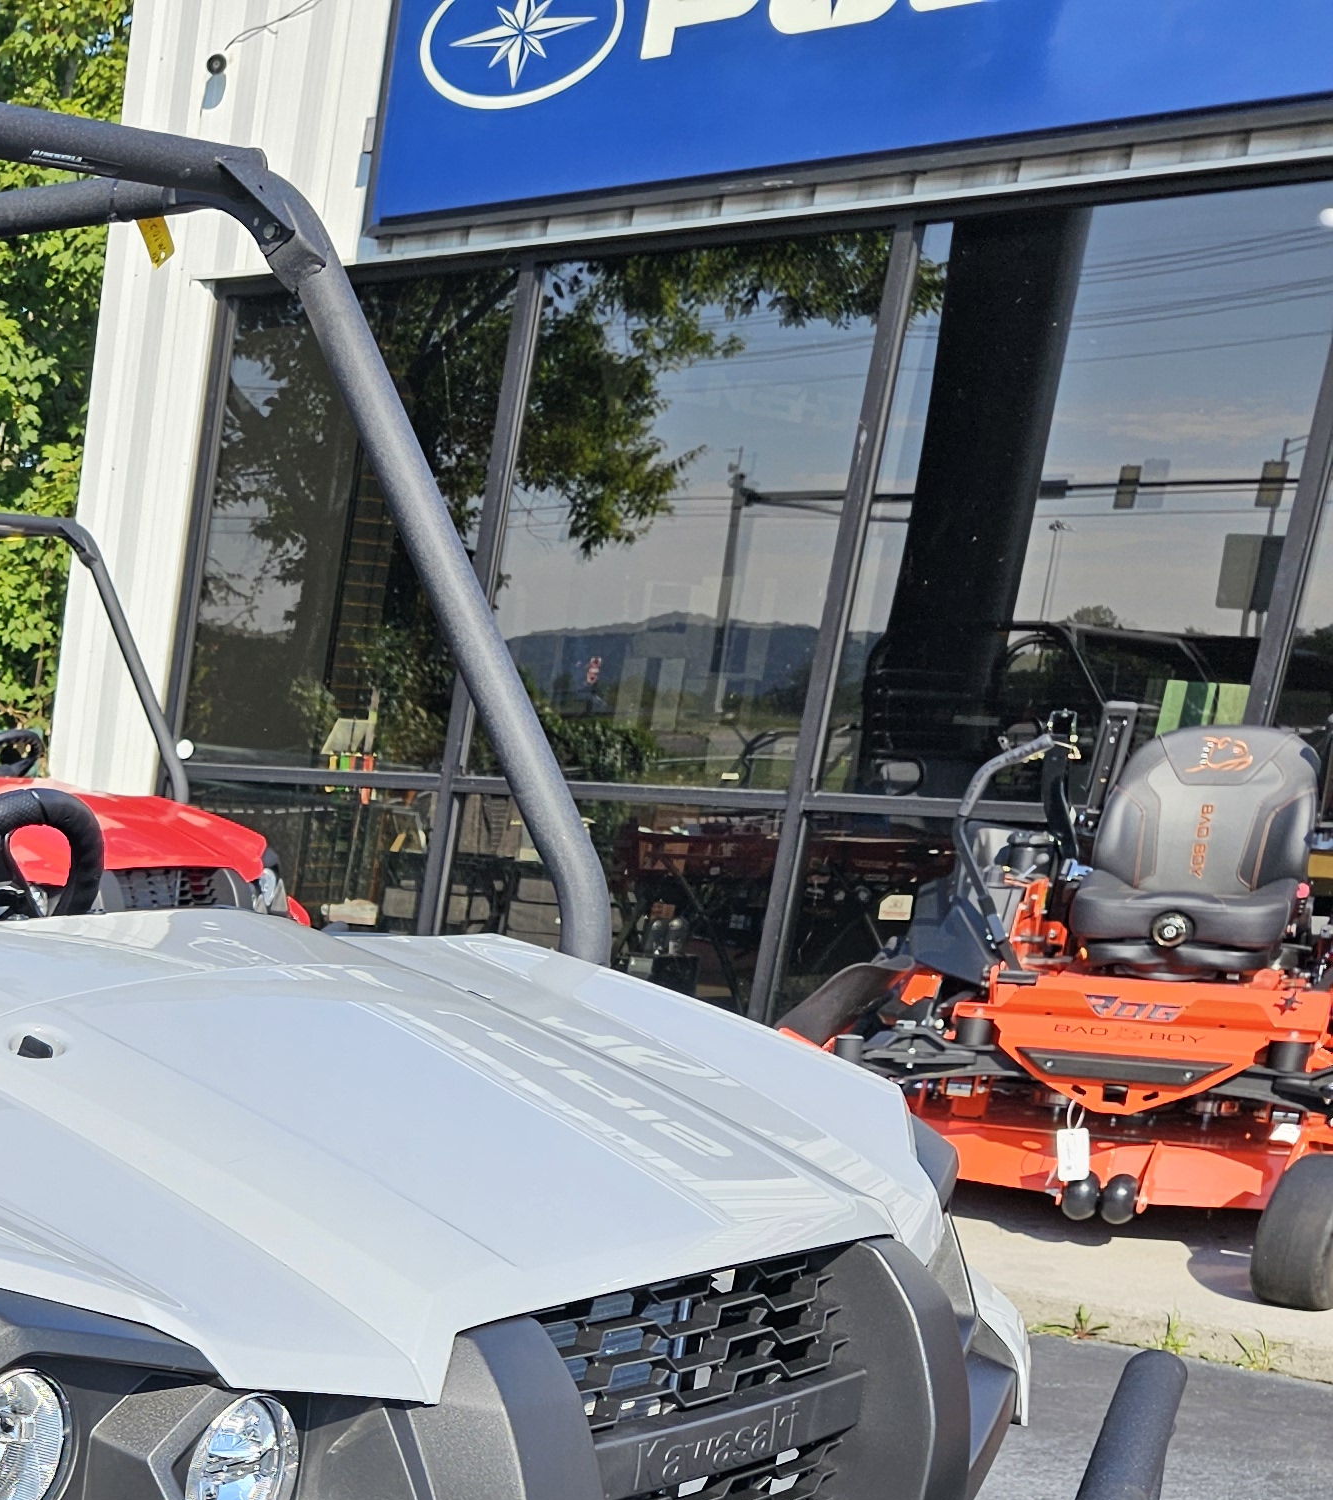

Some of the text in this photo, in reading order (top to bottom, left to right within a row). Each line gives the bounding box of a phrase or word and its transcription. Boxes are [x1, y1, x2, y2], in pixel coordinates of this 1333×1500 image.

[1190, 803, 1214, 880] BAD BOY
[1053, 1024, 1206, 1044] BAD BOY
[634, 1400, 800, 1491] Kawasaki
